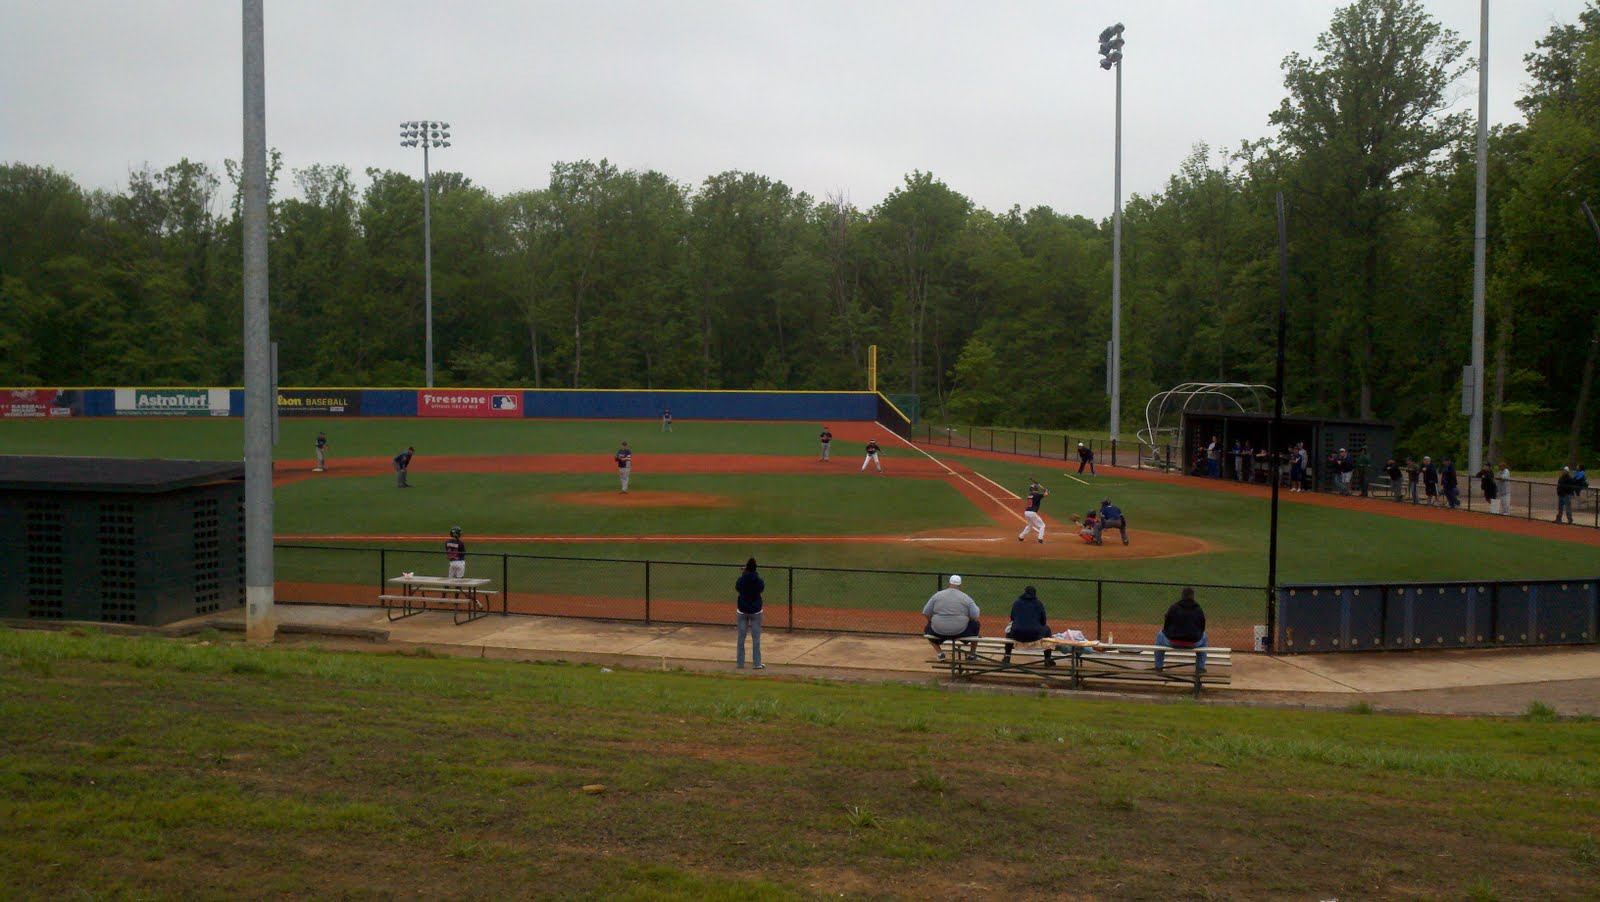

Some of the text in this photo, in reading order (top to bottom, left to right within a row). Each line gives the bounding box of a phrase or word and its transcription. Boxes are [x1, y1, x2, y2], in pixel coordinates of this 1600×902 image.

[138, 394, 206, 406] AstroTurf
[305, 398, 348, 406] BASEBALL
[423, 394, 486, 405] Firestone
